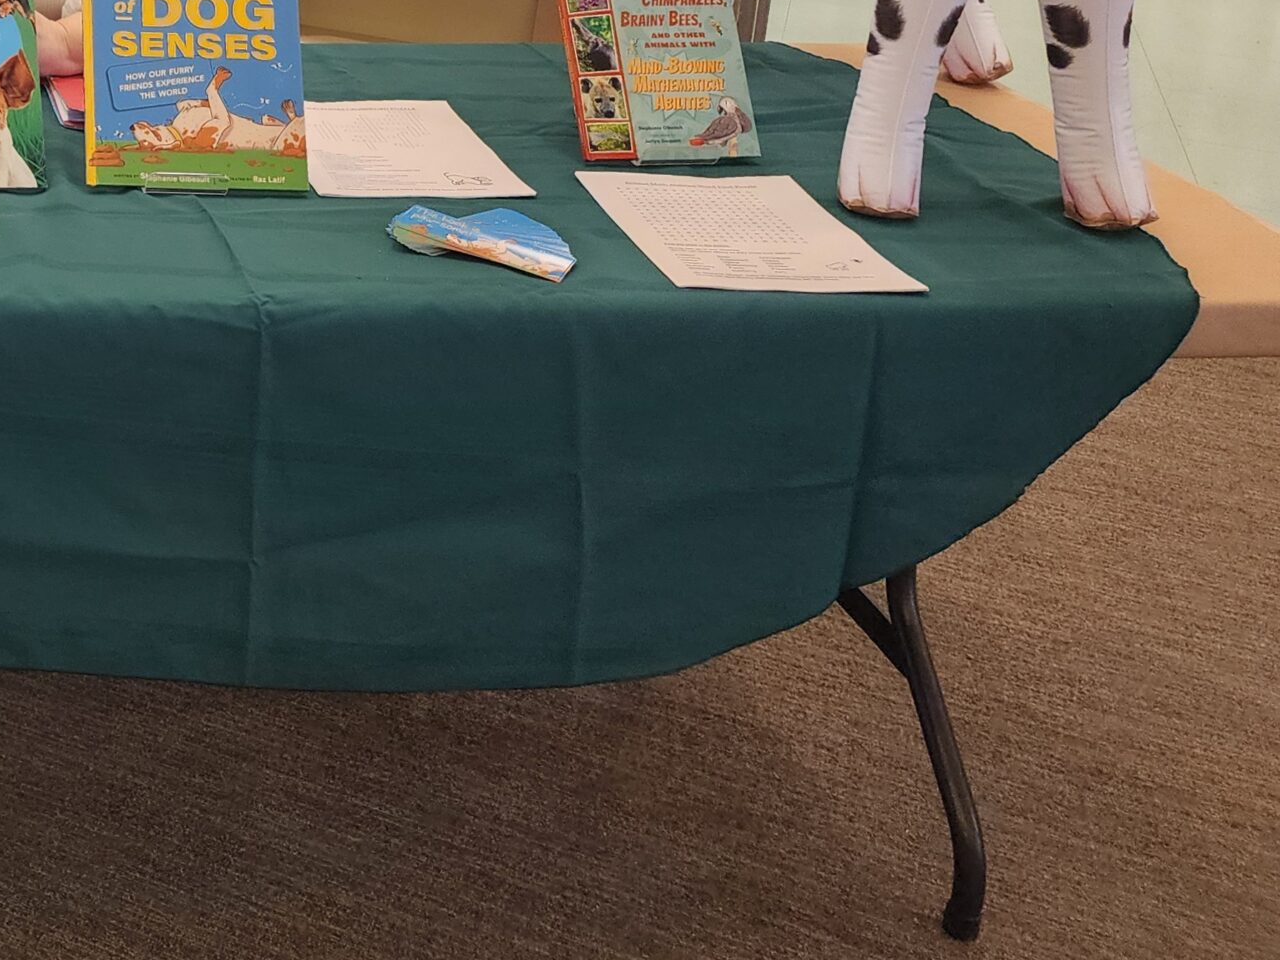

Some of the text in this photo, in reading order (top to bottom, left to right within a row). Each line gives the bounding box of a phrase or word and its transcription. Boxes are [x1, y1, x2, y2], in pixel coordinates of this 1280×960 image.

[112, 31, 277, 60] SENSES
[125, 72, 146, 81] HOW
[169, 65, 194, 75] FURRY
[119, 75, 205, 92] FRIENDS EXPERIENCE
[140, 87, 188, 100] THE WORLD
